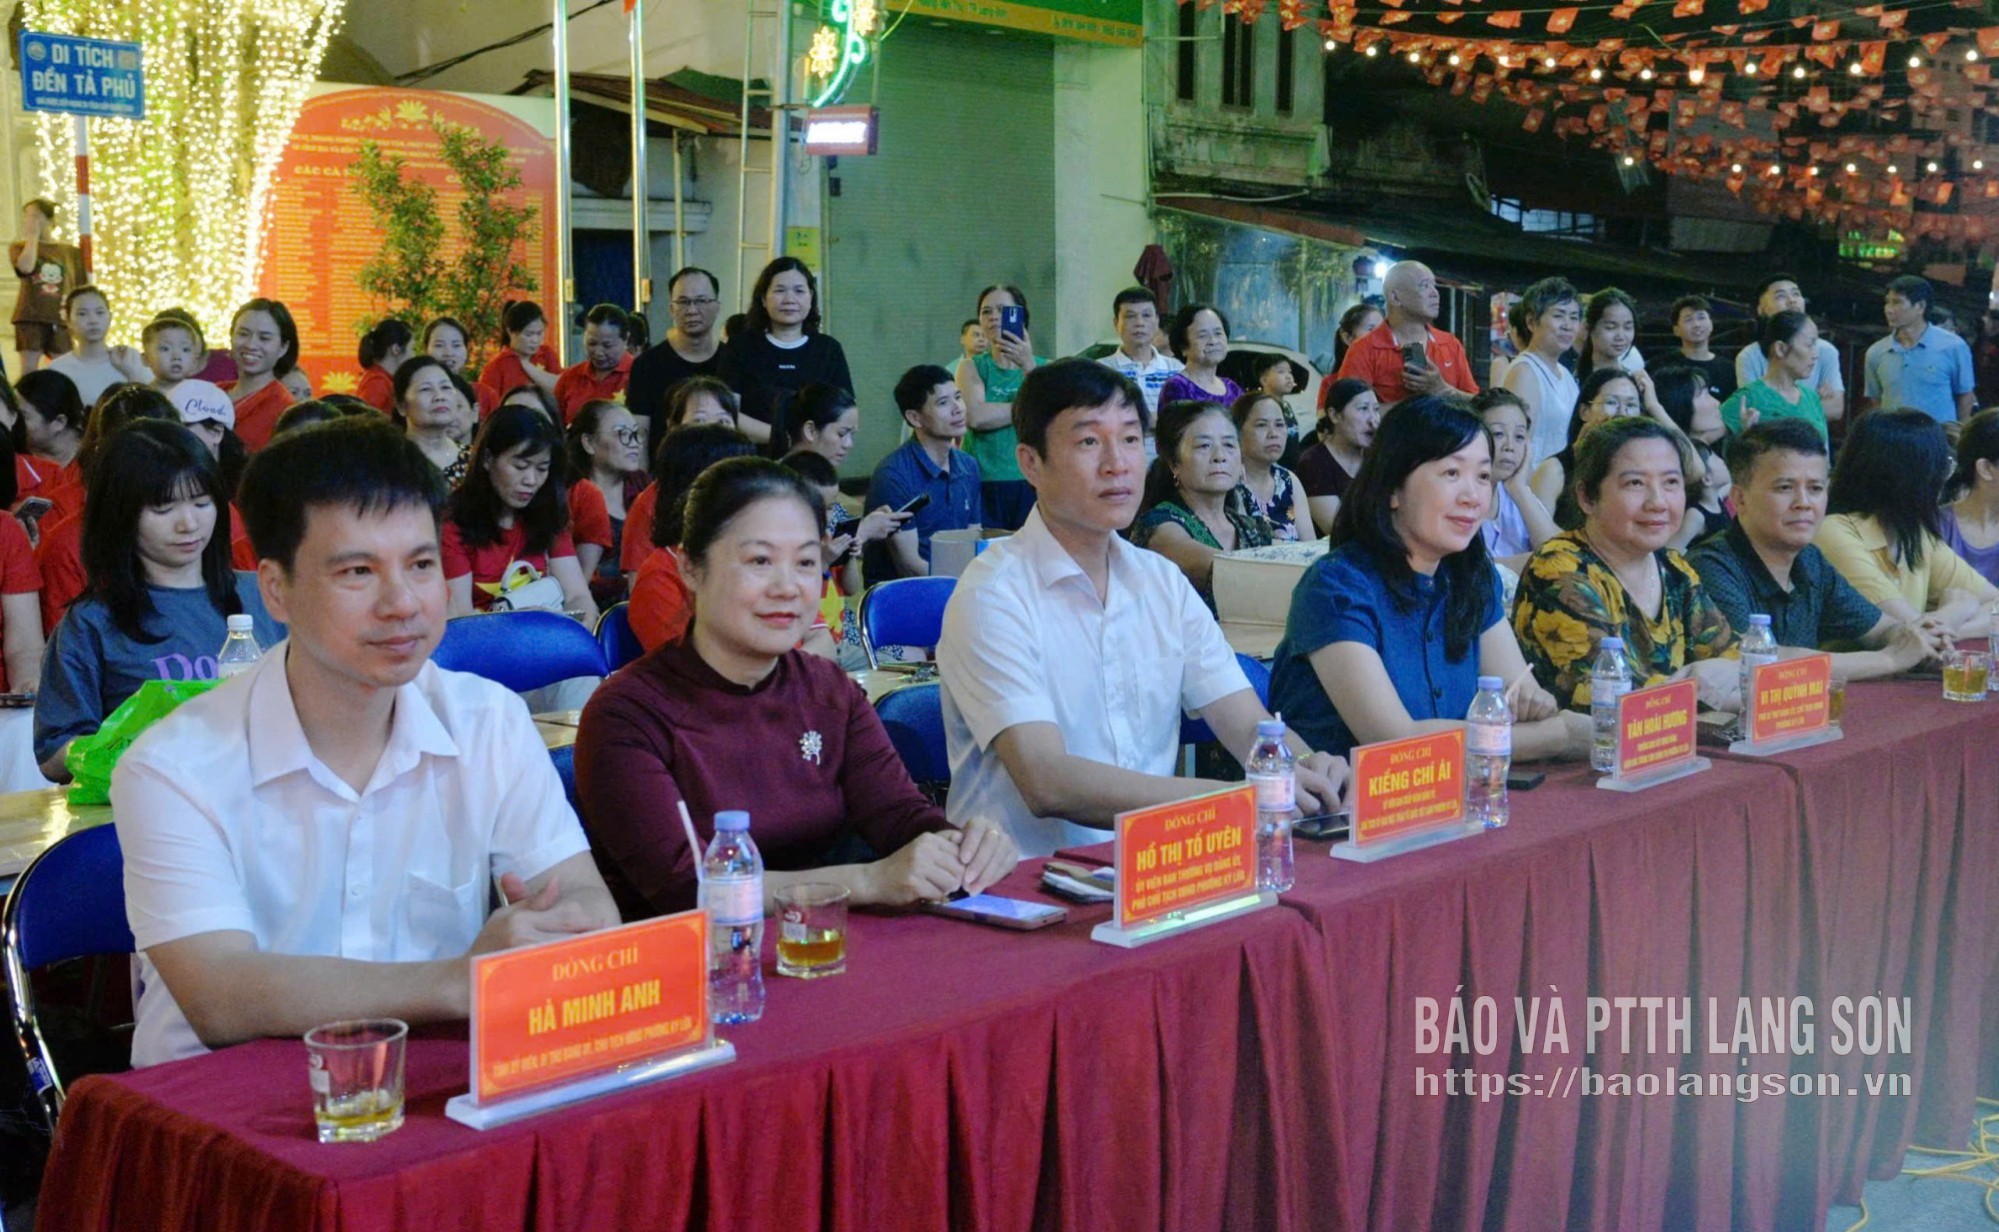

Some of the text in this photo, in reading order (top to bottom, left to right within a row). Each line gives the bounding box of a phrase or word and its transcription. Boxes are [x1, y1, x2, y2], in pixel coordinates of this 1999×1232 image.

[51, 42, 114, 68] DI TÍCH
[101, 72, 136, 99] PHỦ
[1160, 841, 1182, 866] THỊ
[1206, 823, 1242, 854] UYÊN
[528, 978, 661, 1036] HÀ MINH ANH
